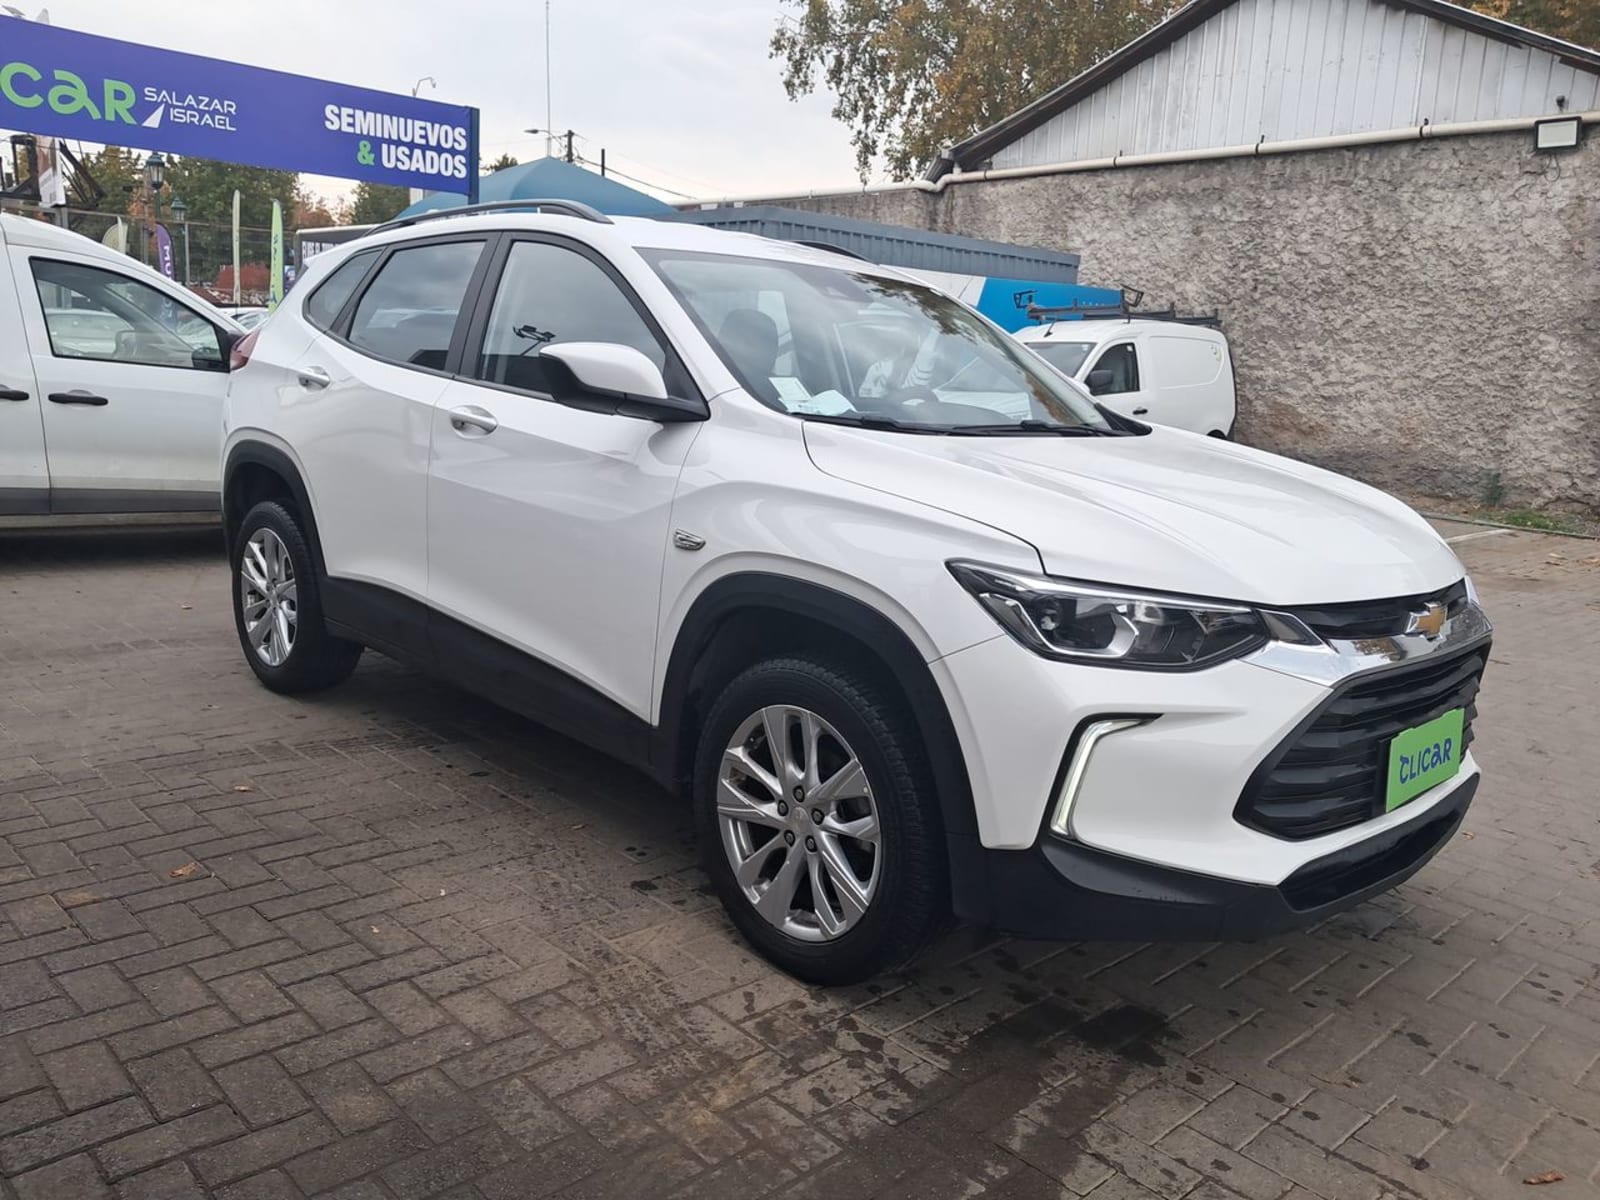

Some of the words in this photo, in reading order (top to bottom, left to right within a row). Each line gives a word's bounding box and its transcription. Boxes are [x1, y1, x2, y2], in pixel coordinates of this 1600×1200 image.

[144, 86, 237, 115] SALAZAR
[169, 107, 237, 131] ISRAEL
[324, 104, 467, 151] SEMINUEVOS
[357, 140, 375, 166] &
[381, 143, 467, 179] USADOS
